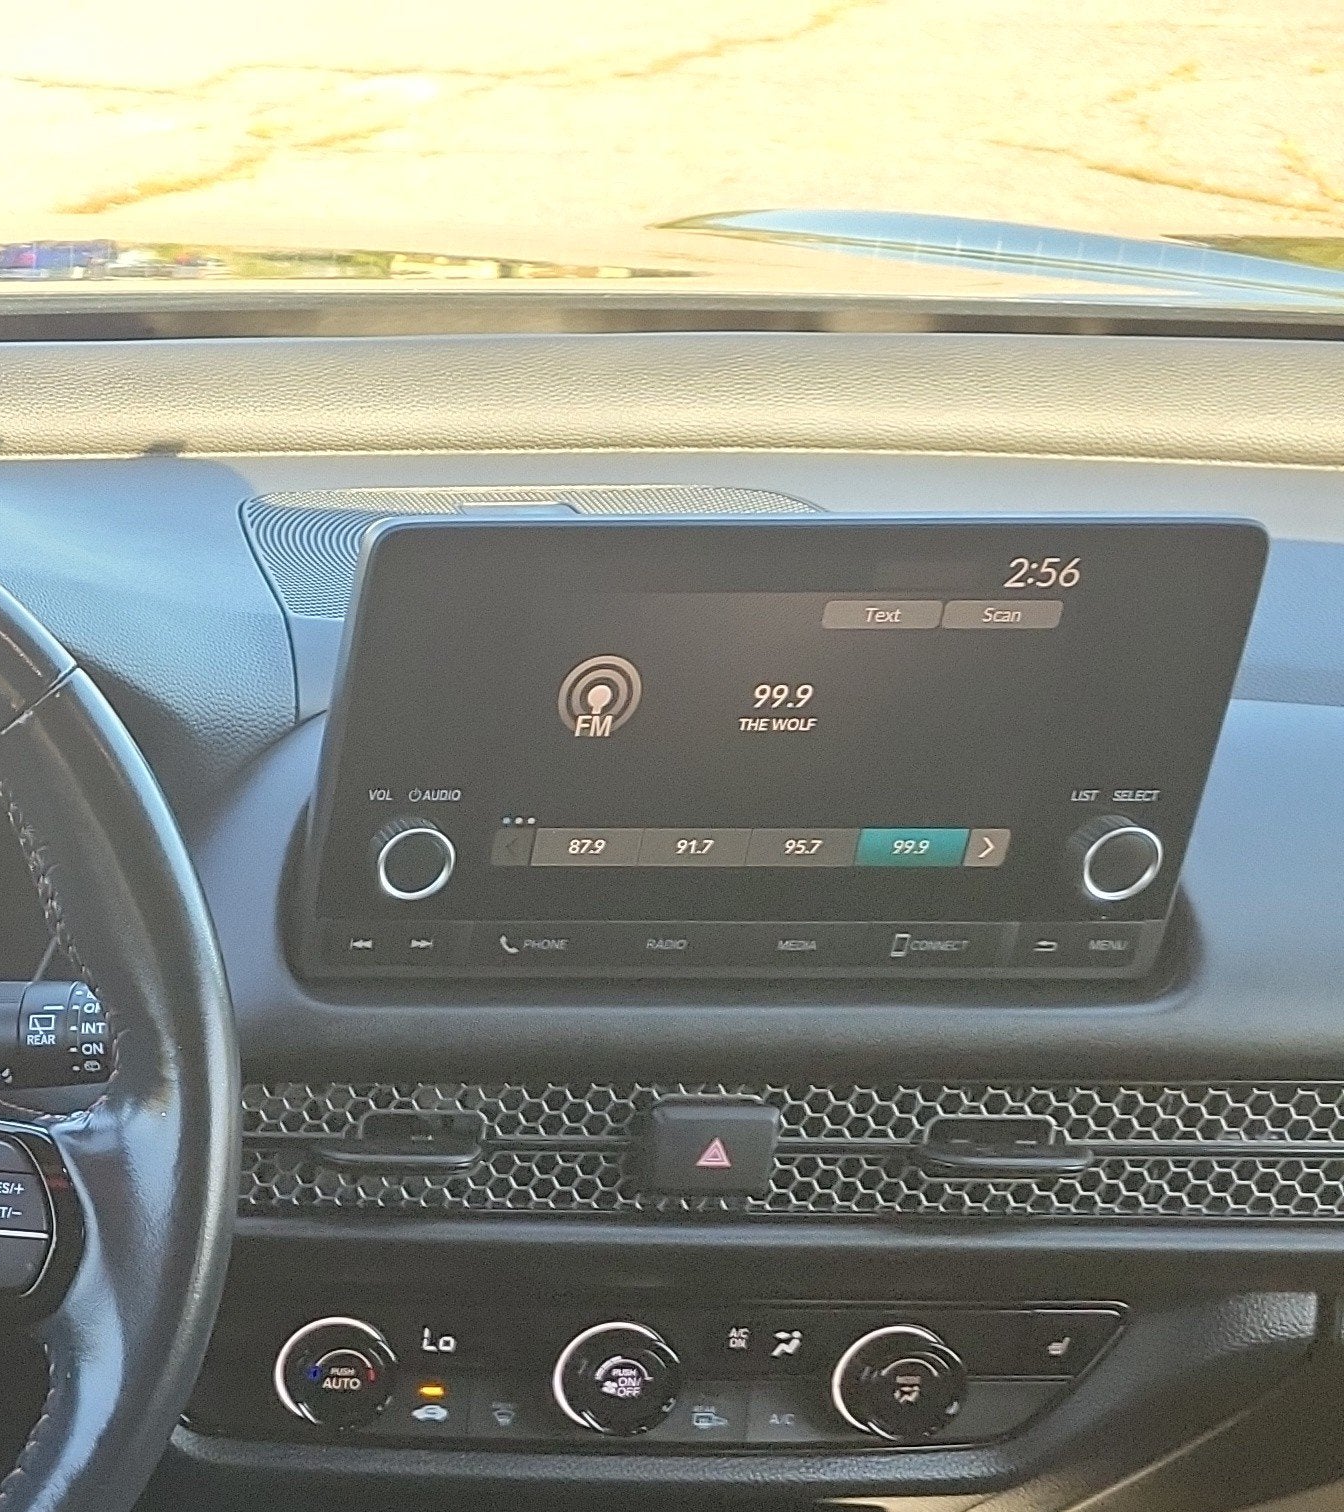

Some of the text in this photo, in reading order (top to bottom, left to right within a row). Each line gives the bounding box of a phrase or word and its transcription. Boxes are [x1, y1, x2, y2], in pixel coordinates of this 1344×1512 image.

[1004, 557, 1081, 588] 2:56
[865, 607, 902, 623] Text
[982, 607, 1021, 623] Scan
[754, 684, 814, 709] 99.9
[574, 714, 614, 737] FM
[739, 718, 818, 731] THE WOLF
[369, 789, 393, 801] VOL
[422, 789, 461, 801] AUDIO
[1071, 790, 1100, 801] LIST
[1112, 790, 1161, 802] SELECT
[568, 838, 606, 855] 87.9
[676, 839, 714, 855] 91.7
[784, 839, 823, 855] 95.7
[892, 839, 930, 855] 99.9
[523, 939, 567, 950] PHONE
[646, 939, 688, 950] RADIO
[777, 939, 817, 951] MEDIA
[81, 1022, 107, 1034] INT
[27, 1034, 56, 1046] REAR
[81, 1042, 105, 1055] ON
[613, 1368, 638, 1376] PUSH
[322, 1378, 361, 1390] AUTO
[616, 1387, 641, 1397] OFF
